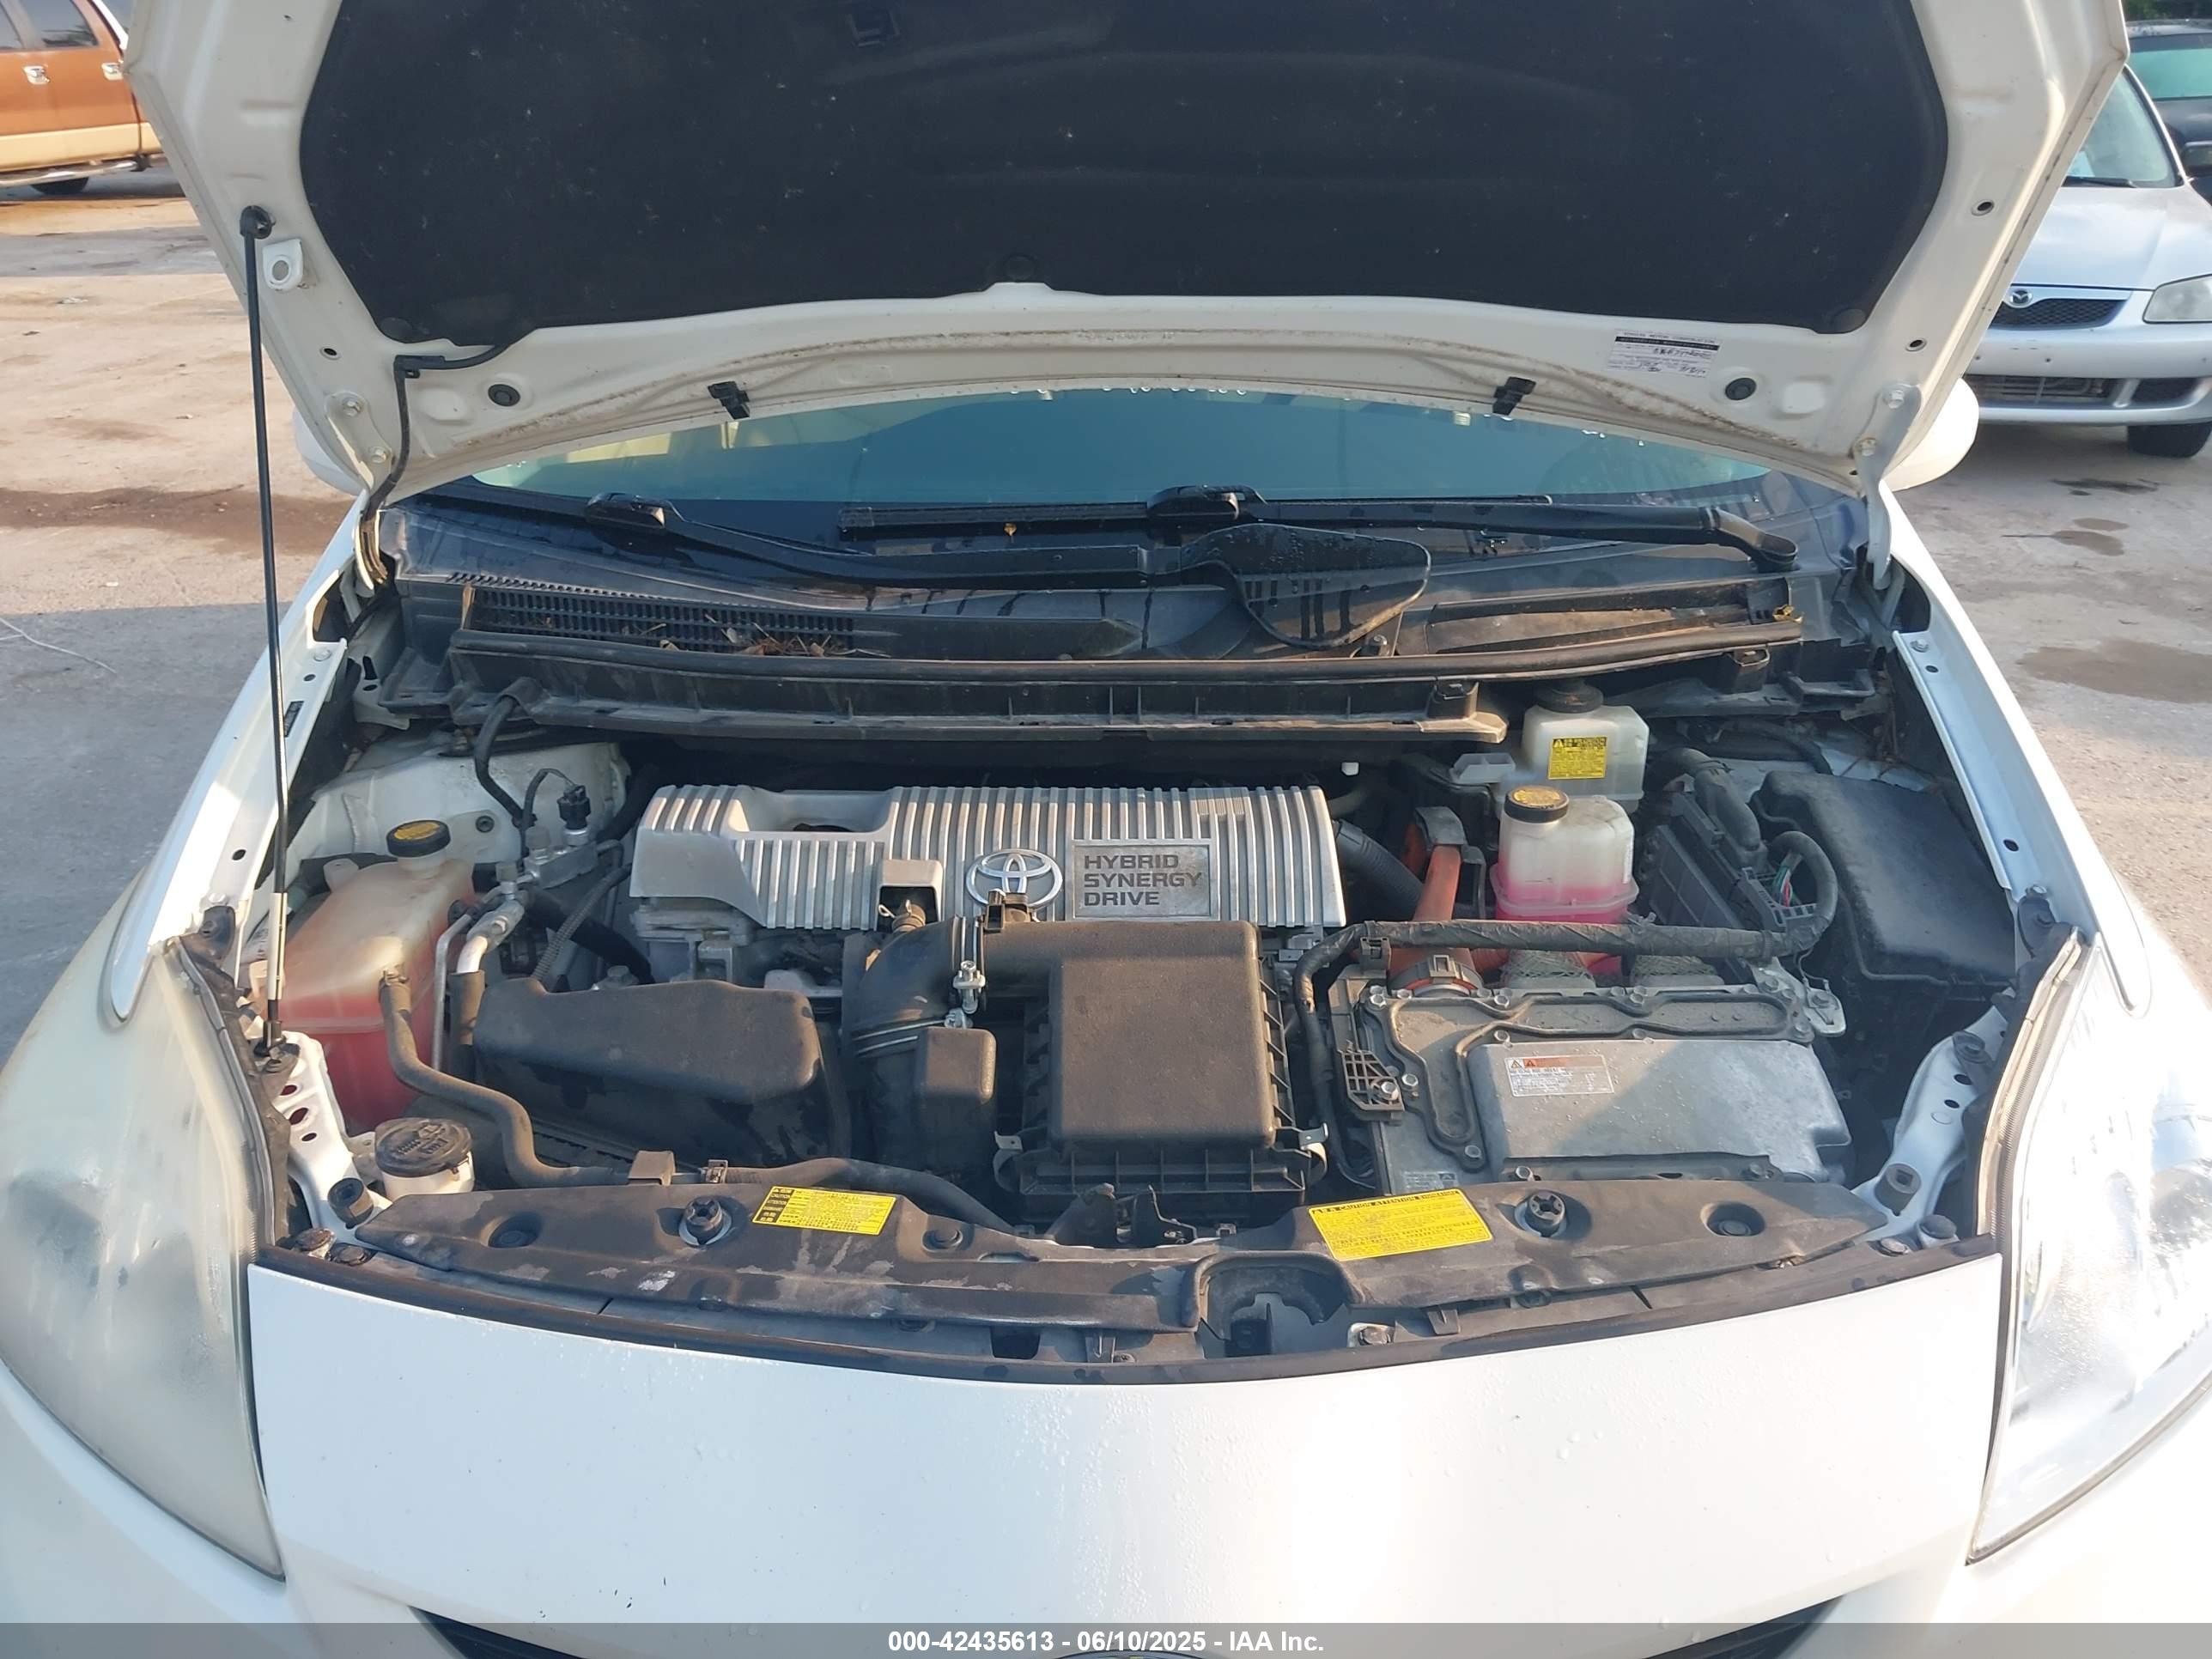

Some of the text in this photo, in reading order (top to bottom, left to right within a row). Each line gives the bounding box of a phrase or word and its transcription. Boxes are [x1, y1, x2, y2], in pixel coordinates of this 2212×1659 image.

[1084, 854, 1179, 869] HYBRID
[1084, 872, 1202, 887] SYNERGY
[1084, 891, 1160, 906] DRIVE
